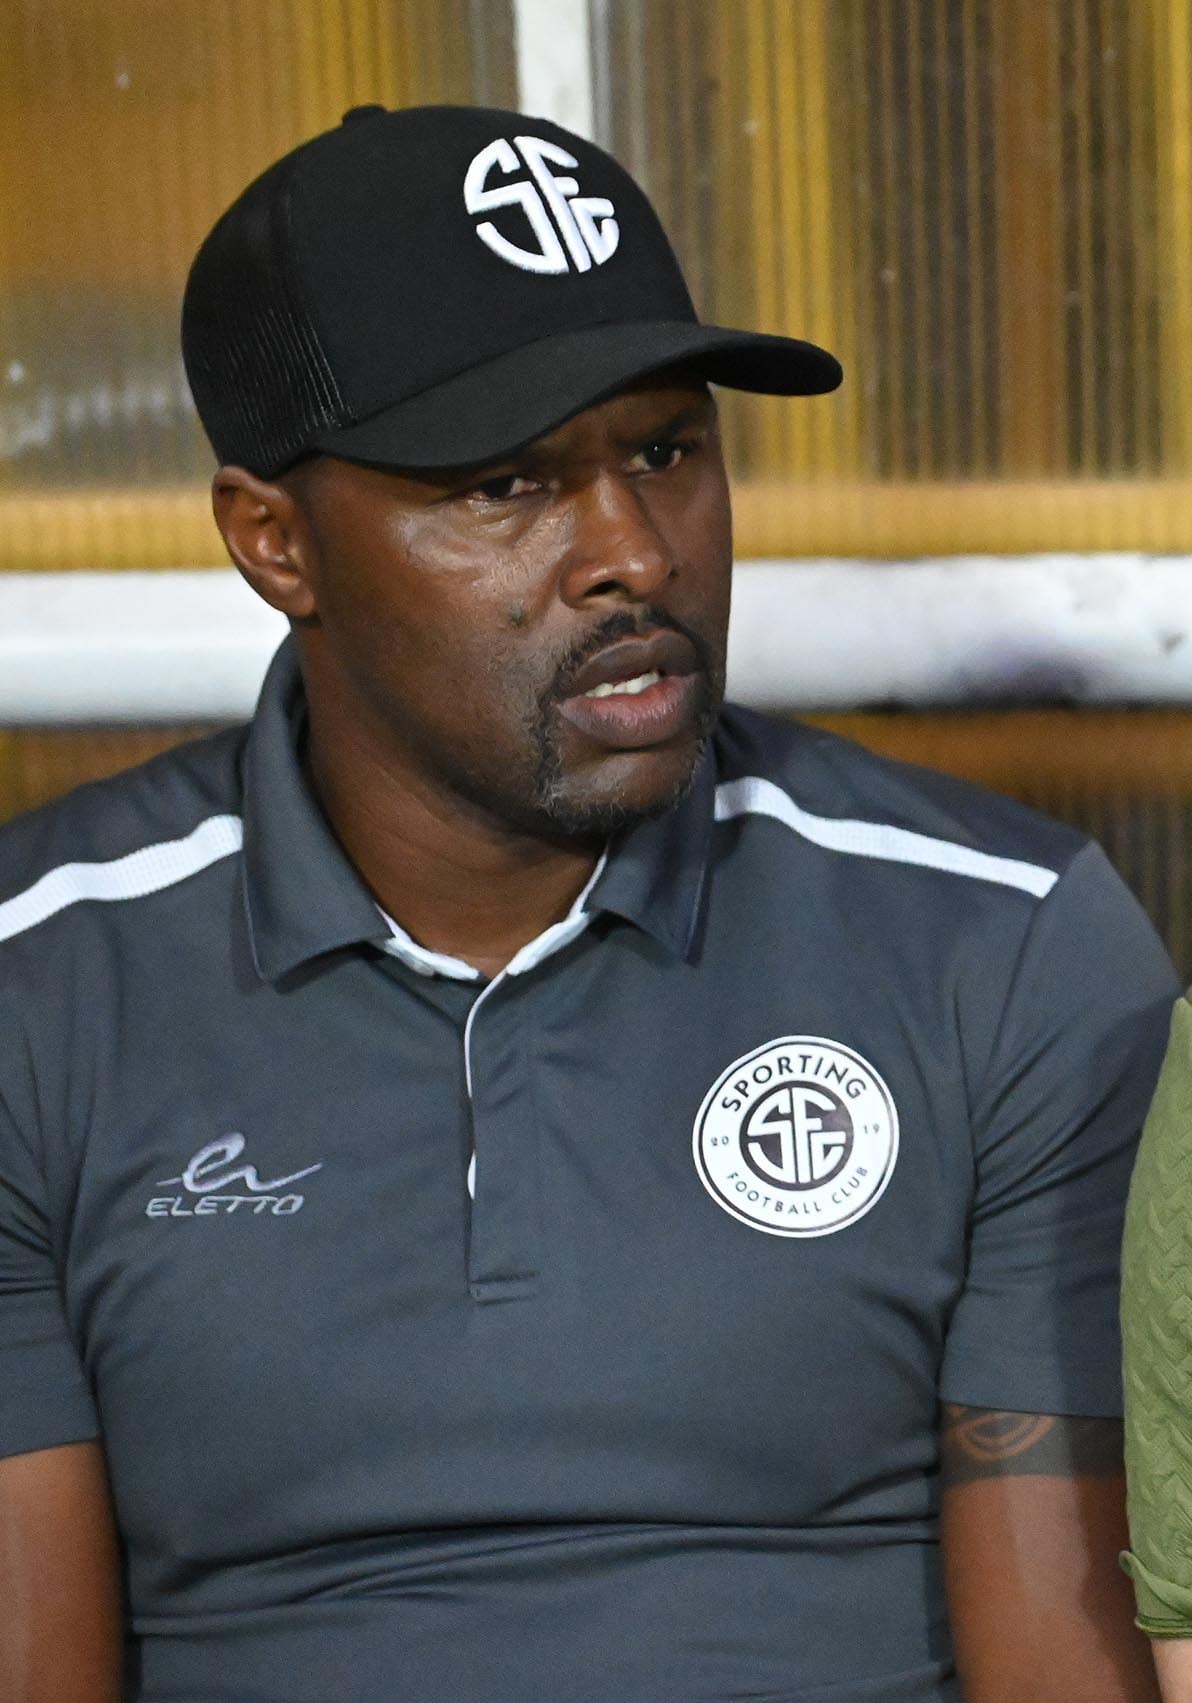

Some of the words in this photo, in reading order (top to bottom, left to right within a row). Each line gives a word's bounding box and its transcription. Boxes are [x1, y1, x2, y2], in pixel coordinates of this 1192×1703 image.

[722, 1055, 867, 1112] SPORTING
[145, 1194, 304, 1218] ELETTO
[727, 1172, 821, 1214] FOOTBALL
[831, 1166, 868, 1204] CLUB
